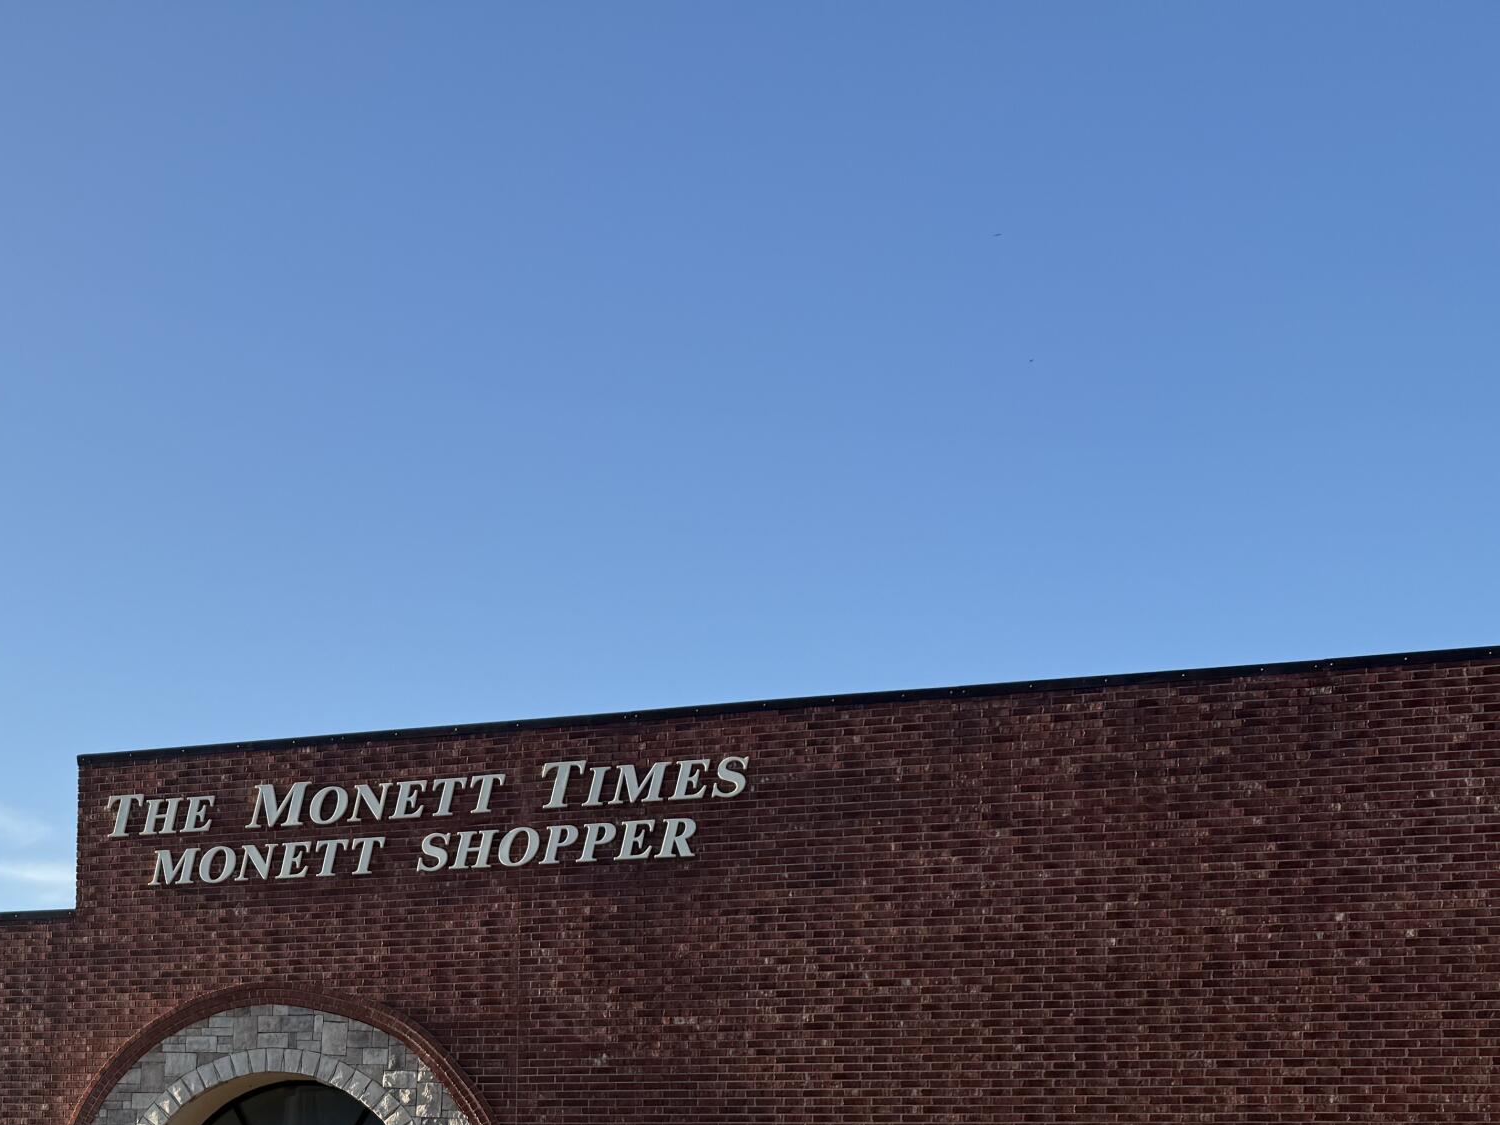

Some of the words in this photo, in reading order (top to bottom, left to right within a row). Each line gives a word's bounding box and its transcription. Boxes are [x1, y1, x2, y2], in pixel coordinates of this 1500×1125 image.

[106, 789, 215, 838] THE
[244, 773, 506, 829] MONETT
[541, 755, 750, 809] TIMES
[147, 836, 386, 886] MONETT
[416, 817, 697, 873] SHOPPER
